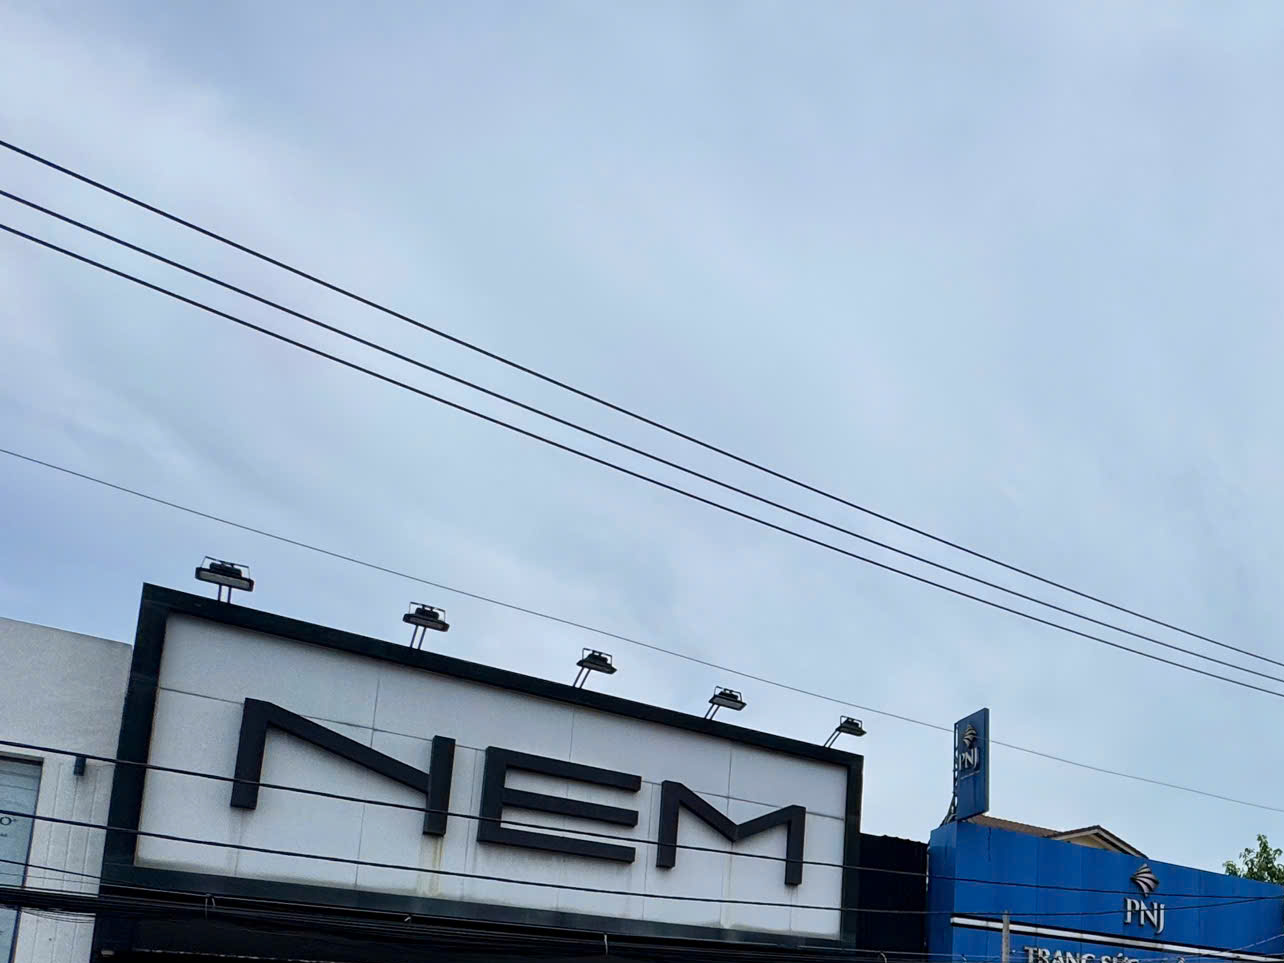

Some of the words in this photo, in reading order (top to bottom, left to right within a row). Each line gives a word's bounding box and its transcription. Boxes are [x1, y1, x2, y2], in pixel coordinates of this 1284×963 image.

[958, 747, 978, 771] PNJ
[231, 697, 806, 887] NEM
[1125, 898, 1166, 934] PNJ
